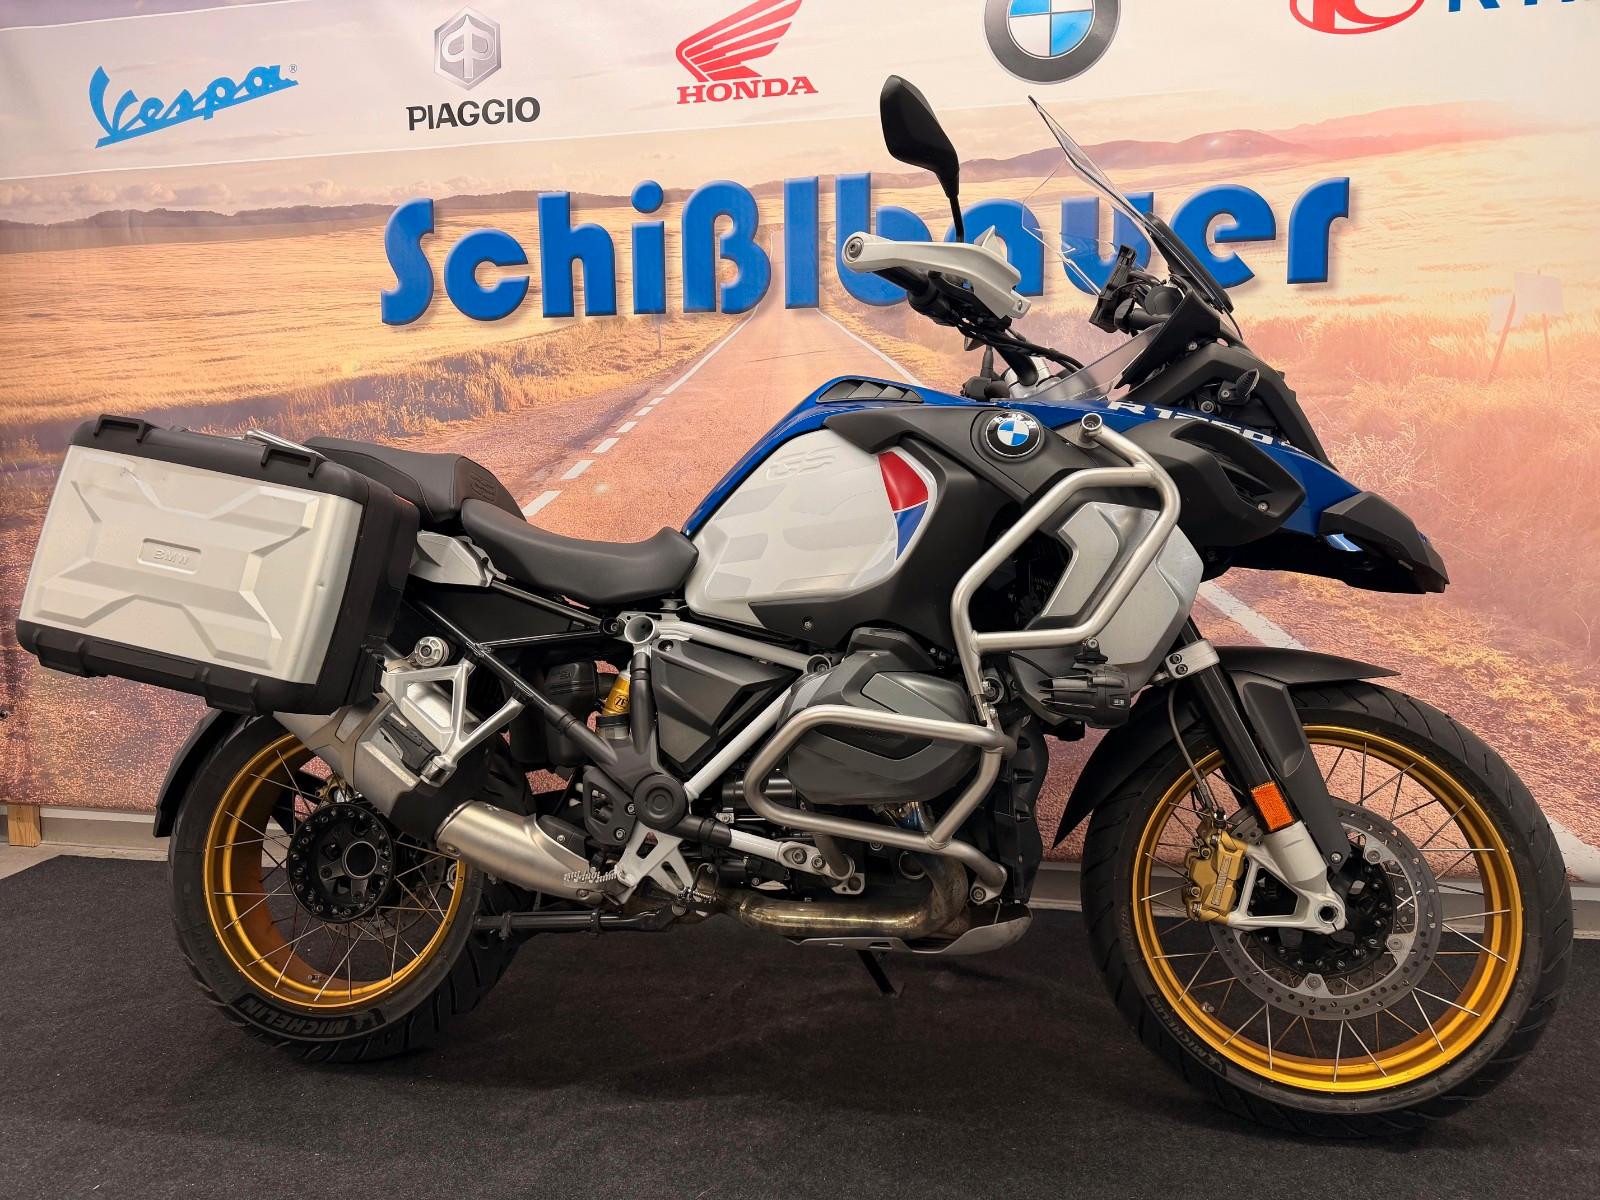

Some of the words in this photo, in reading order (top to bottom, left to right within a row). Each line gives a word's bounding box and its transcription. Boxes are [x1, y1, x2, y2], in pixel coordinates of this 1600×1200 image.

[89, 65, 298, 149] Vespa
[676, 75, 819, 104] HONDA
[406, 96, 541, 131] PIAGGIO
[239, 998, 350, 1035] MICHELIN
